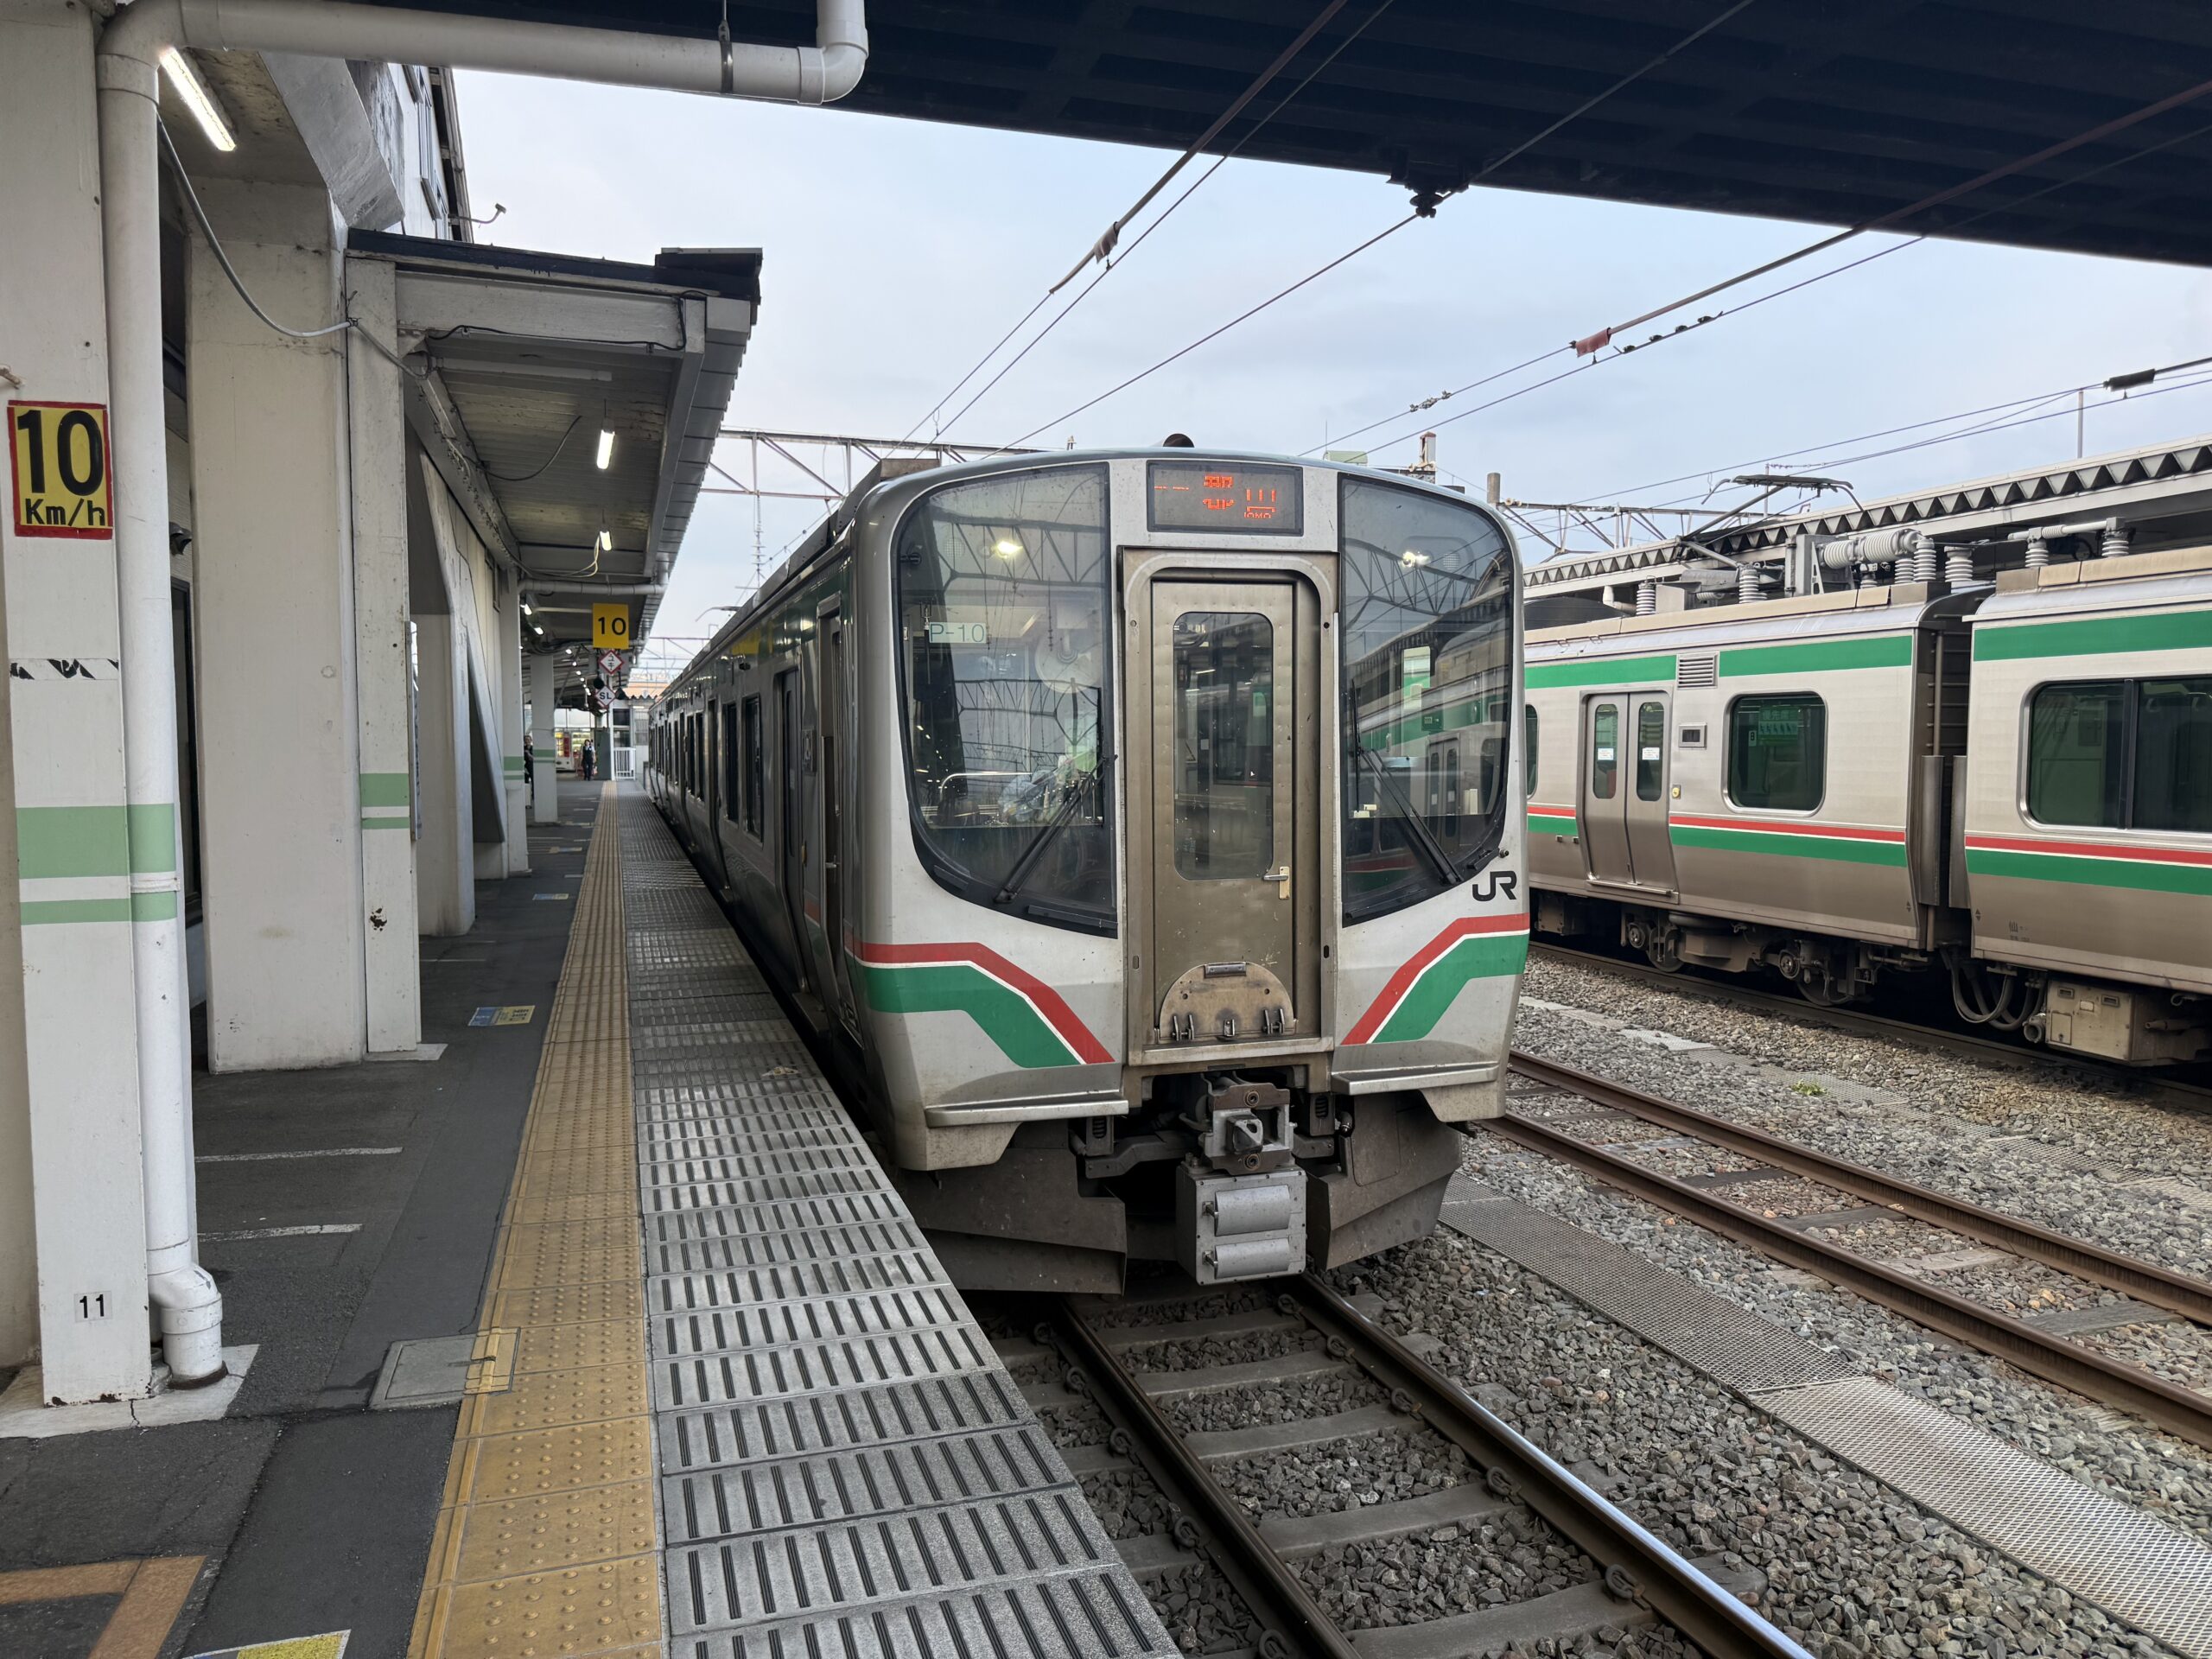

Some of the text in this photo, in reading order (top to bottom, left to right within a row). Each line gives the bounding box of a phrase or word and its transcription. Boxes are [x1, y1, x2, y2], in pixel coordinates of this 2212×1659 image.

[17, 410, 104, 496] 10
[25, 498, 105, 526] Km/h
[598, 616, 626, 635] 10
[1472, 870, 1517, 901] JR
[79, 1294, 104, 1319] 11
